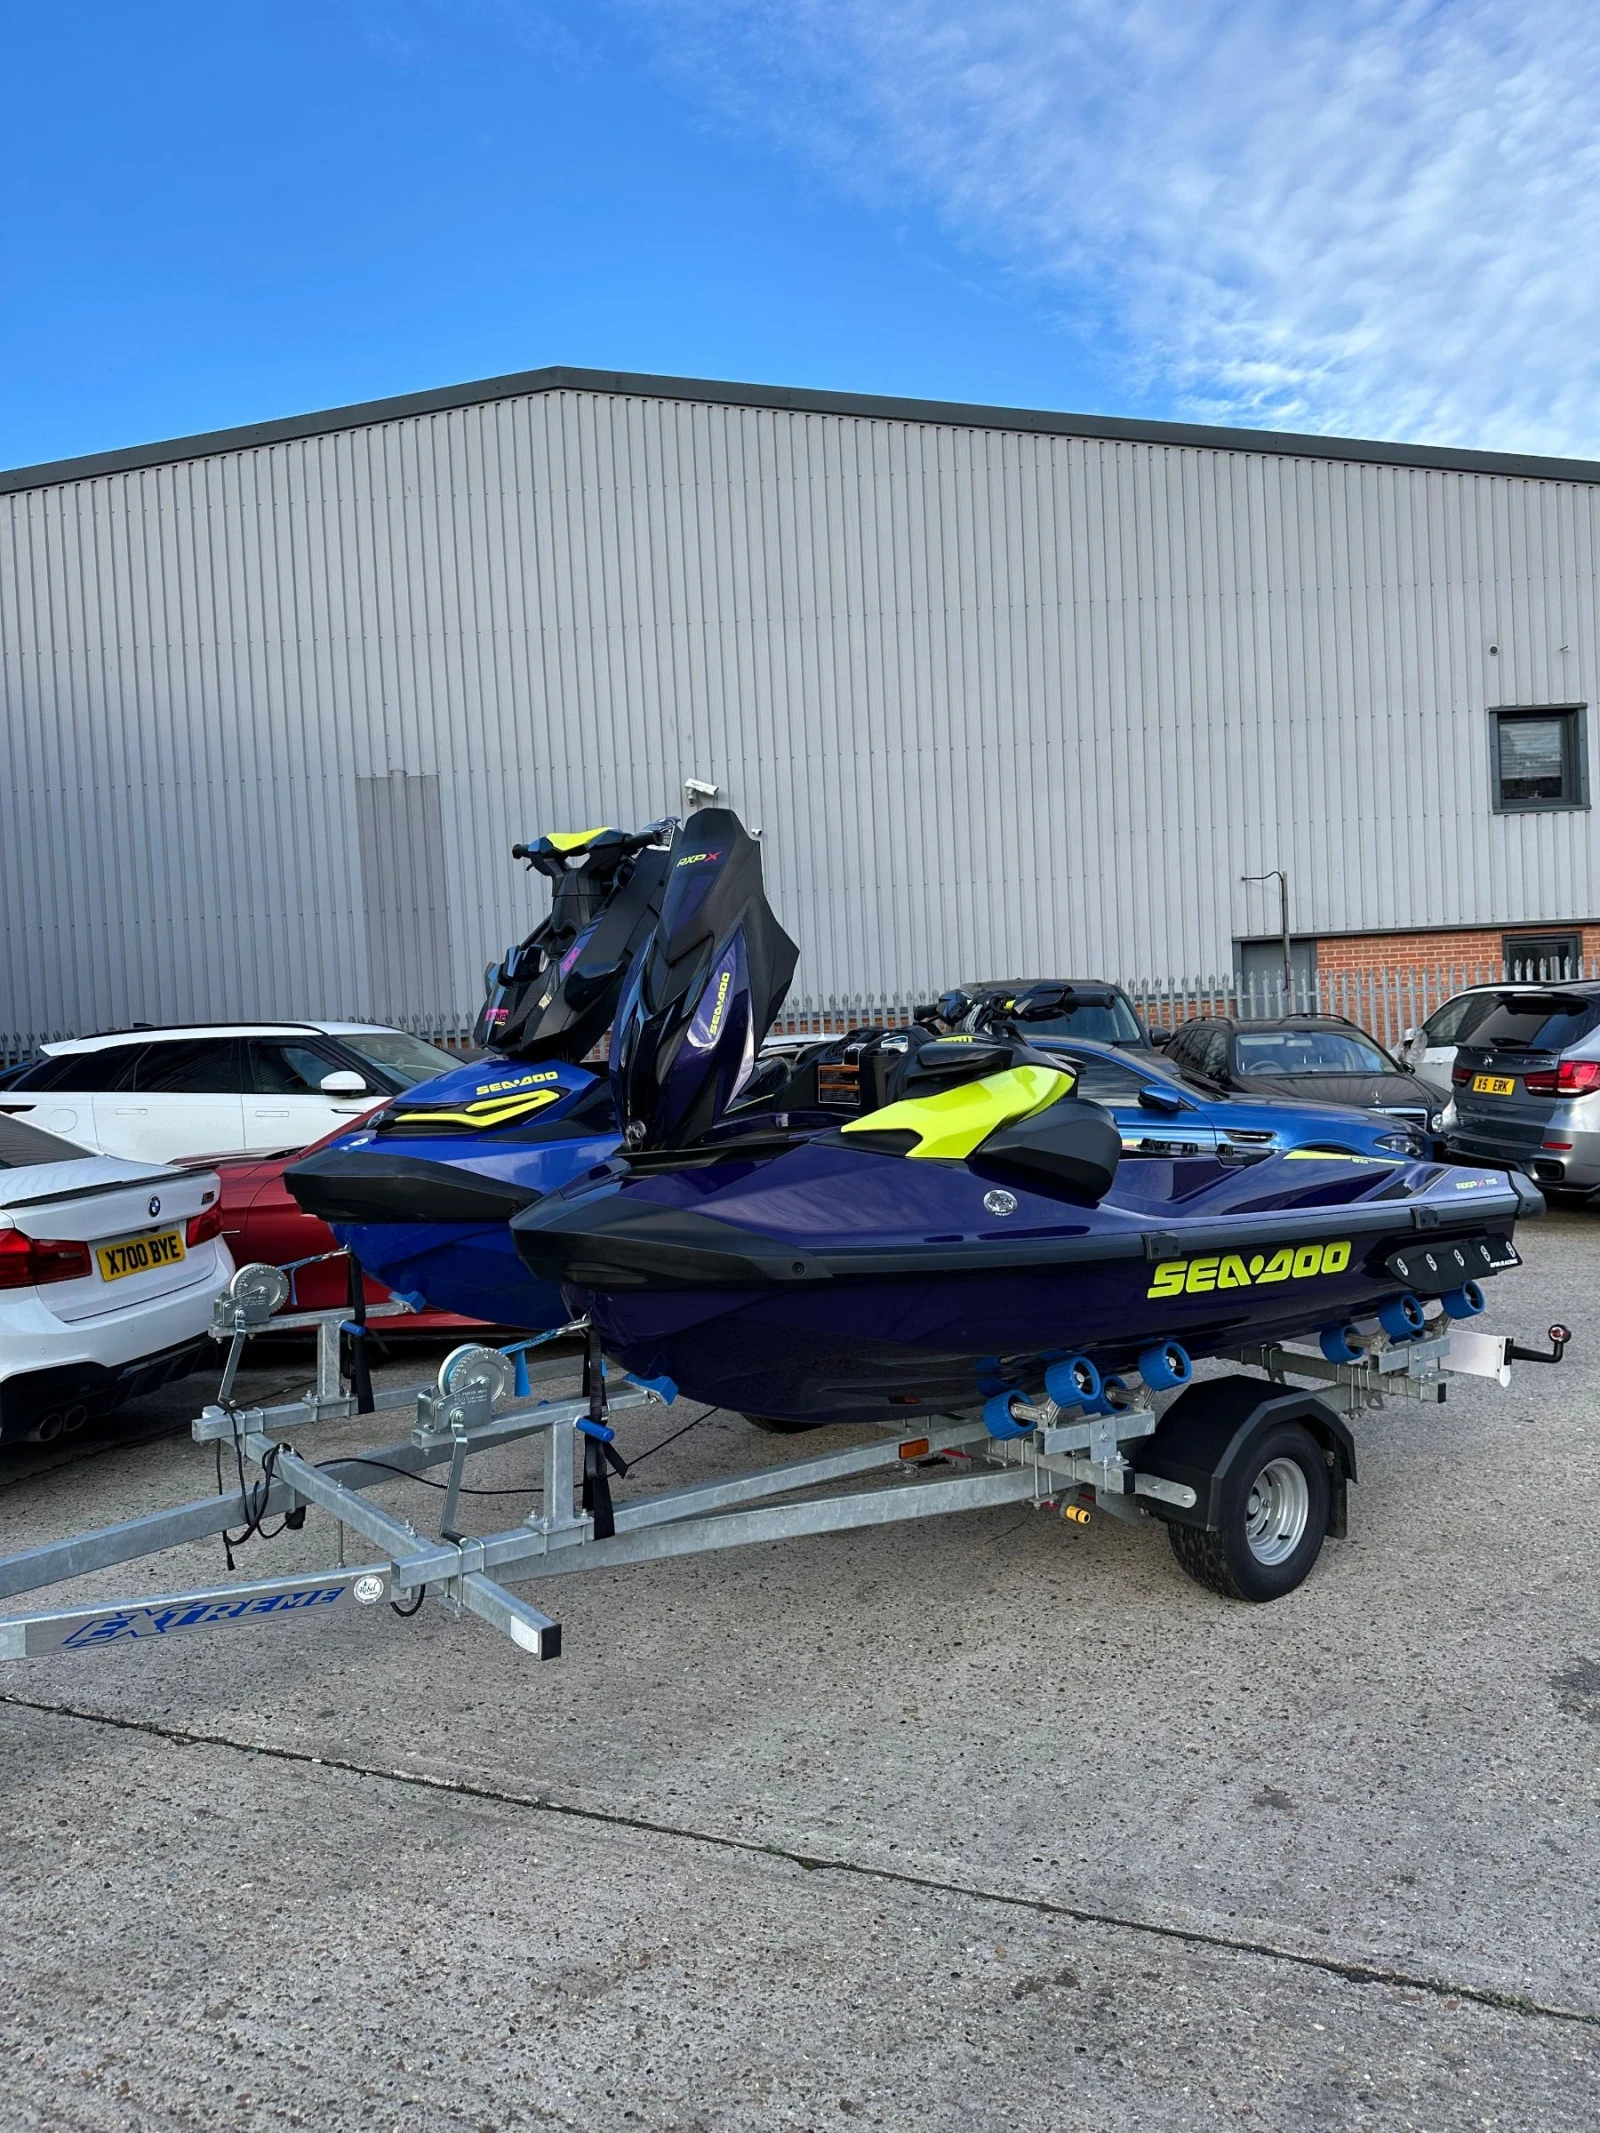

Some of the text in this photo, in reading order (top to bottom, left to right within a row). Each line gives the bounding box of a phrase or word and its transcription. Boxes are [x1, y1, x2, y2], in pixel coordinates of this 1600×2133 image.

[1476, 1076, 1509, 1093] X5 ERK
[105, 1235, 181, 1275] X700 BYE
[61, 1586, 347, 1649] EXTREME
